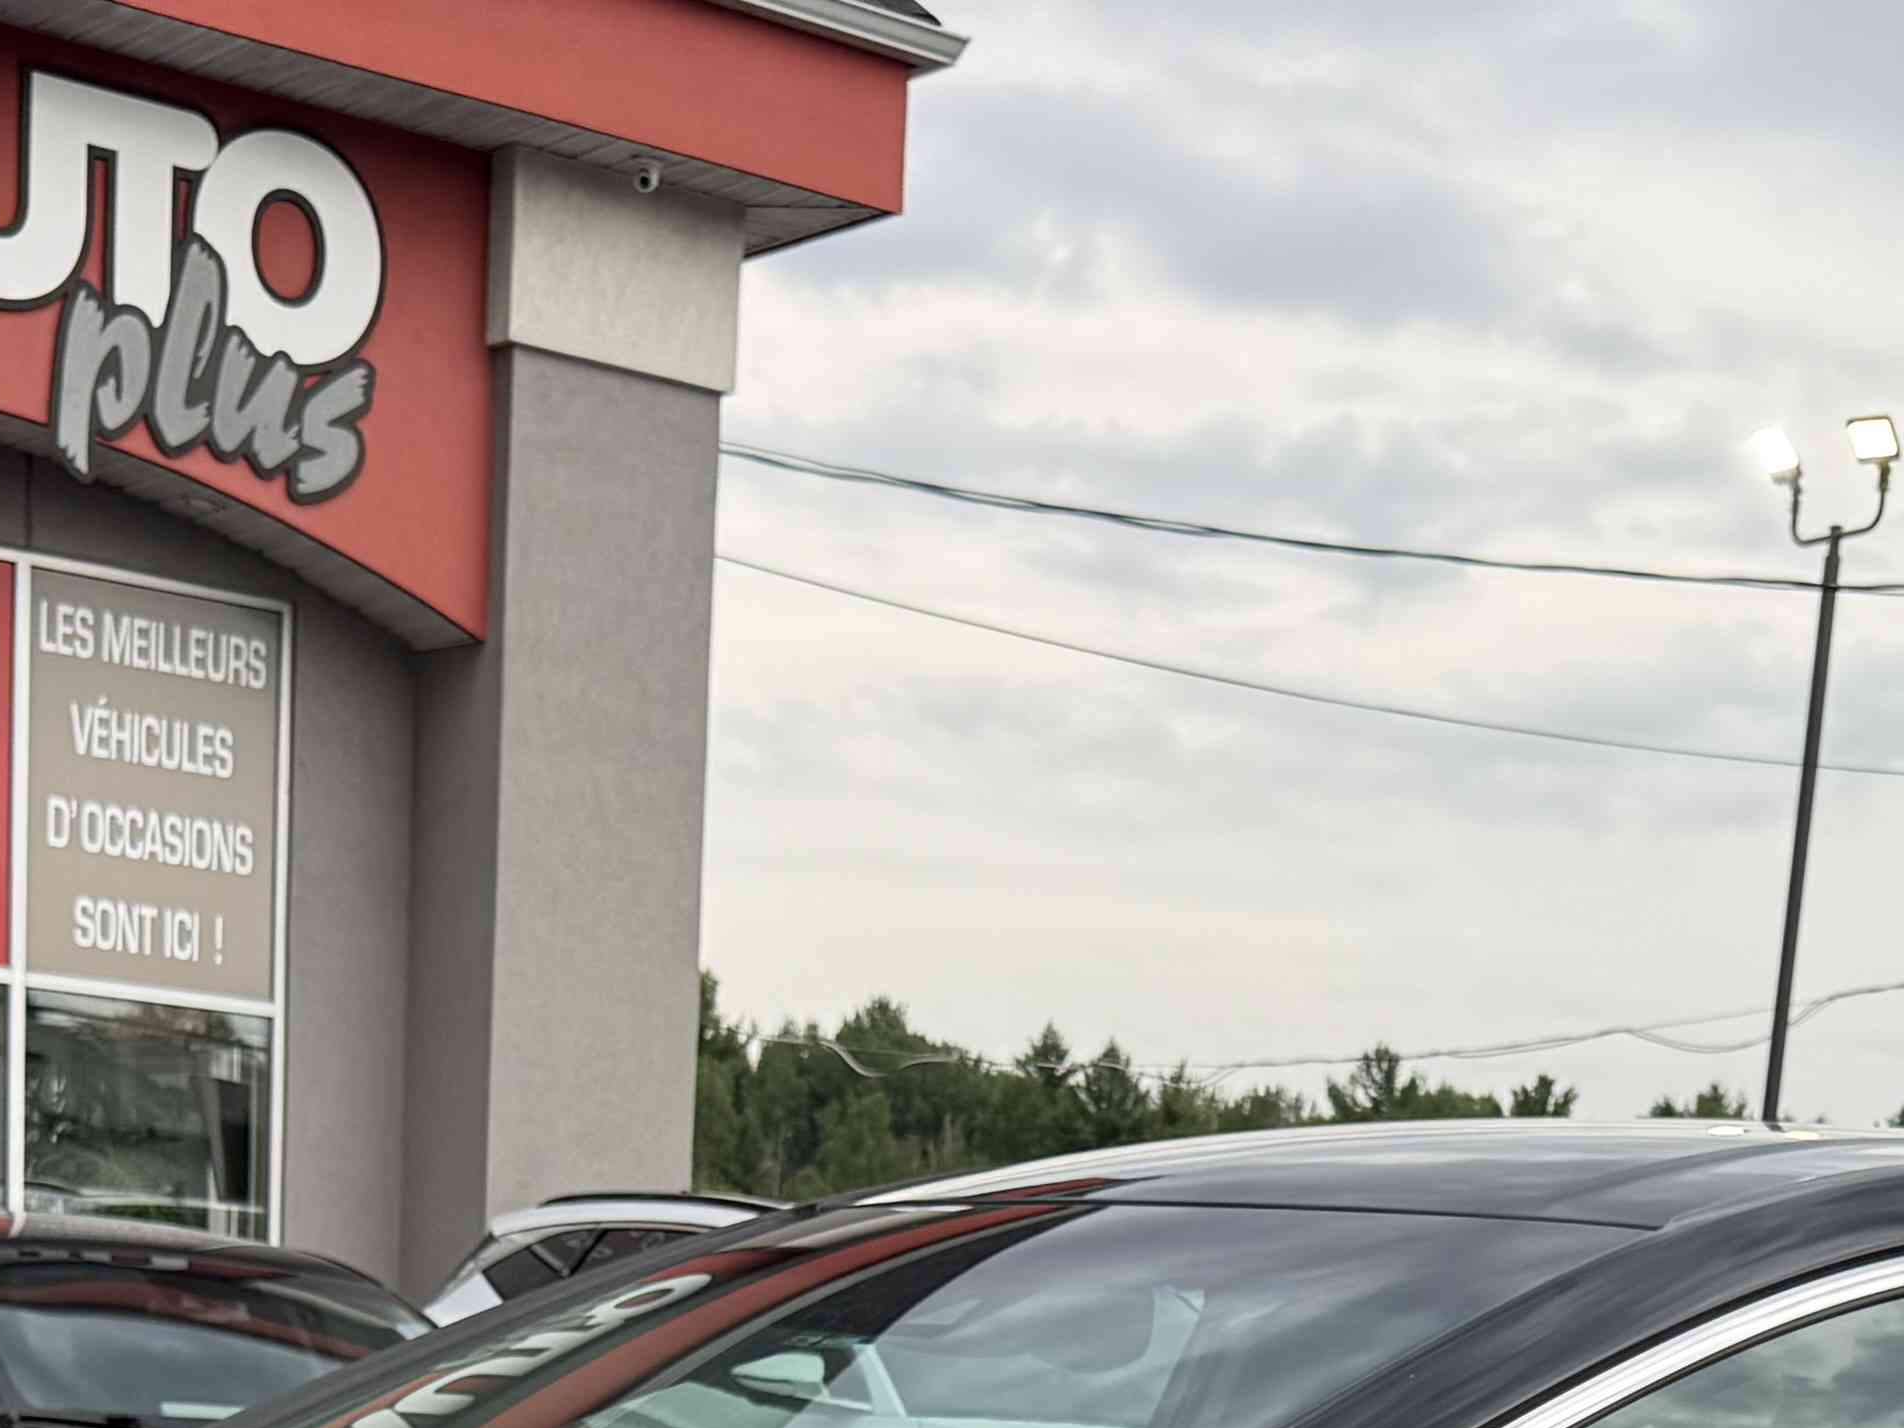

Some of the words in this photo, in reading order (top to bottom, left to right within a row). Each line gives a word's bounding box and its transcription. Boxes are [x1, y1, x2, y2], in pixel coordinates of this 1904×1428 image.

[49, 233, 376, 504] plus
[39, 600, 96, 660] LES
[100, 608, 267, 690] MEILLEURS
[69, 694, 234, 779] VÉHICULES
[73, 894, 158, 957] SONT
[162, 909, 200, 963] ICI
